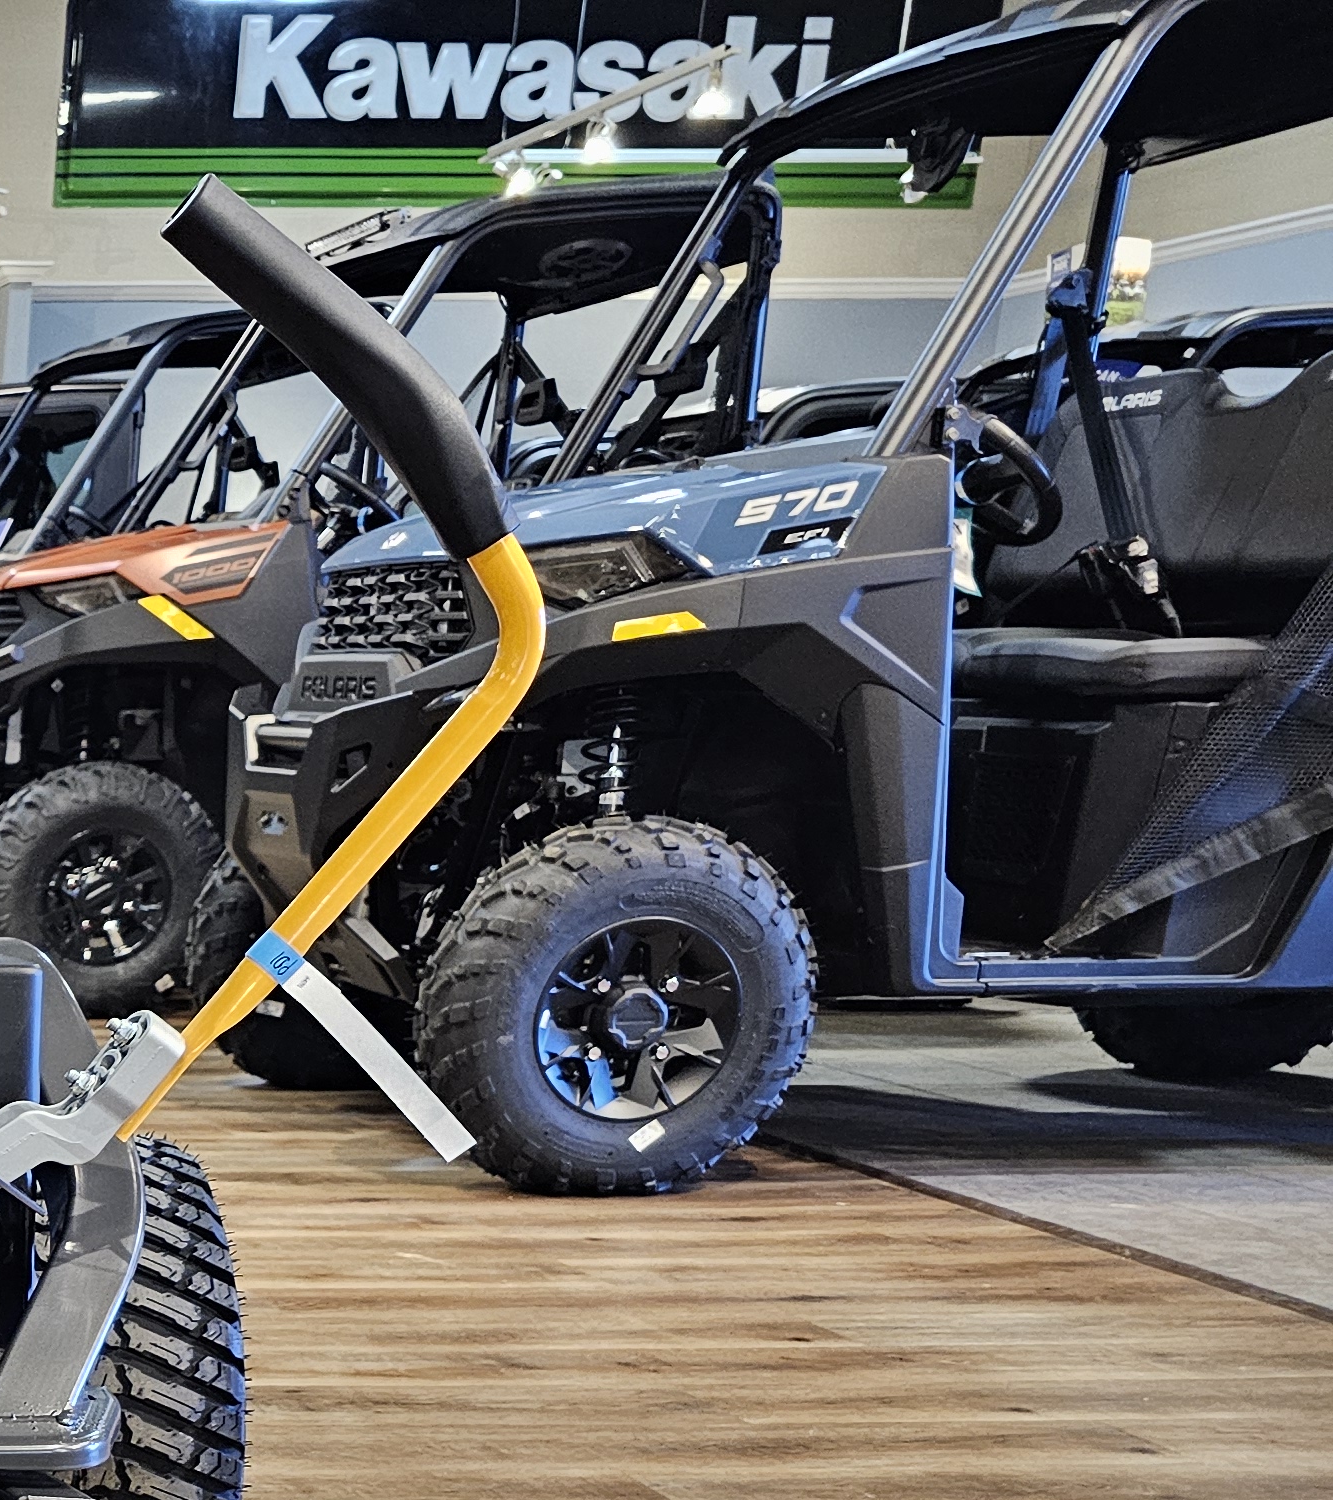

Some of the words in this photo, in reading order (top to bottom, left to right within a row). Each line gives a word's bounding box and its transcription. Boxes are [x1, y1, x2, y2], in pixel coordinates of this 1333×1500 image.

[234, 14, 833, 123] Kawasaki
[734, 480, 859, 527] 570
[173, 557, 256, 583] 1000
[301, 674, 377, 700] POLARIS
